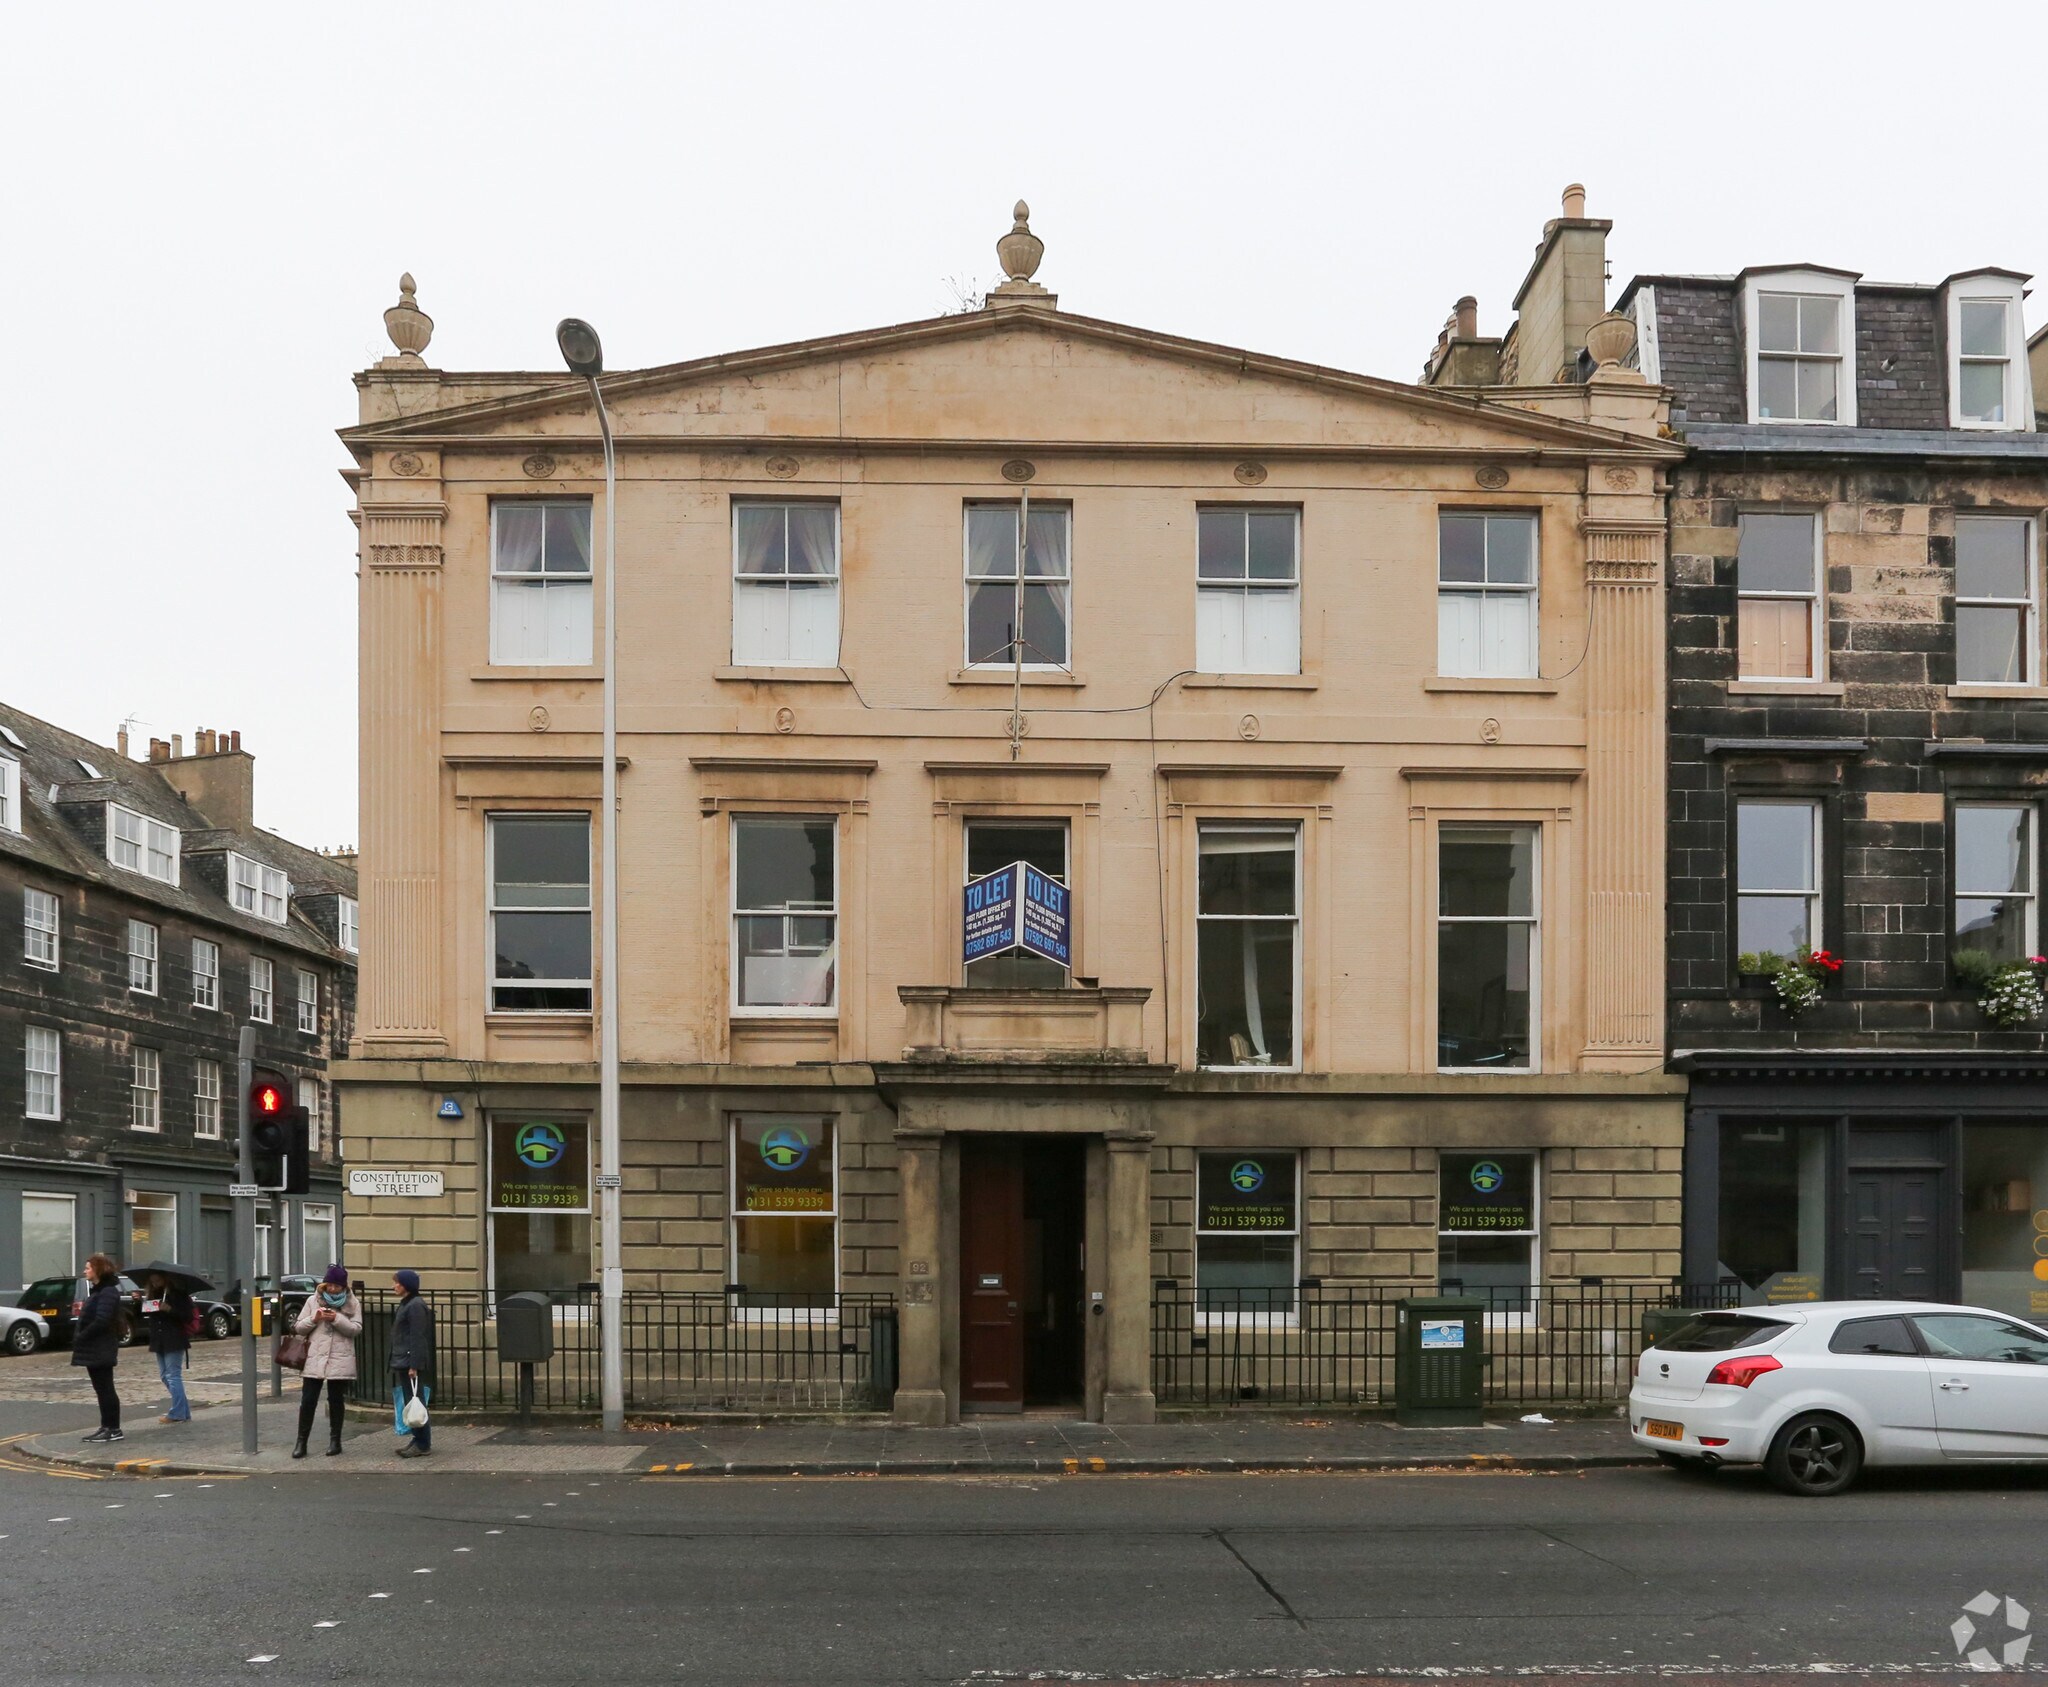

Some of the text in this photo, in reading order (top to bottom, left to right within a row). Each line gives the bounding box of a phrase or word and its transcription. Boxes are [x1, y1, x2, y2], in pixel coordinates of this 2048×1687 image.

[967, 874, 1009, 912] TO LET
[1027, 872, 1063, 913] TO LET
[966, 900, 1011, 923] FIRST FLOOR OFFICE SUITE
[1035, 903, 1046, 915] FLOOR
[1046, 908, 1057, 921] OFFICE
[1000, 928, 1011, 943] 543
[1025, 927, 1043, 947] 07582
[1056, 943, 1066, 958] 543
[353, 1174, 439, 1183] CONSTITUTION
[376, 1184, 419, 1193] STREET
[502, 1193, 579, 1204] 0131 539 9339
[746, 1197, 823, 1207] 0131 539 9339
[1208, 1216, 1285, 1226] 0131 539 9339
[1449, 1217, 1525, 1226] 0131 539 9339
[913, 1263, 926, 1272] 92
